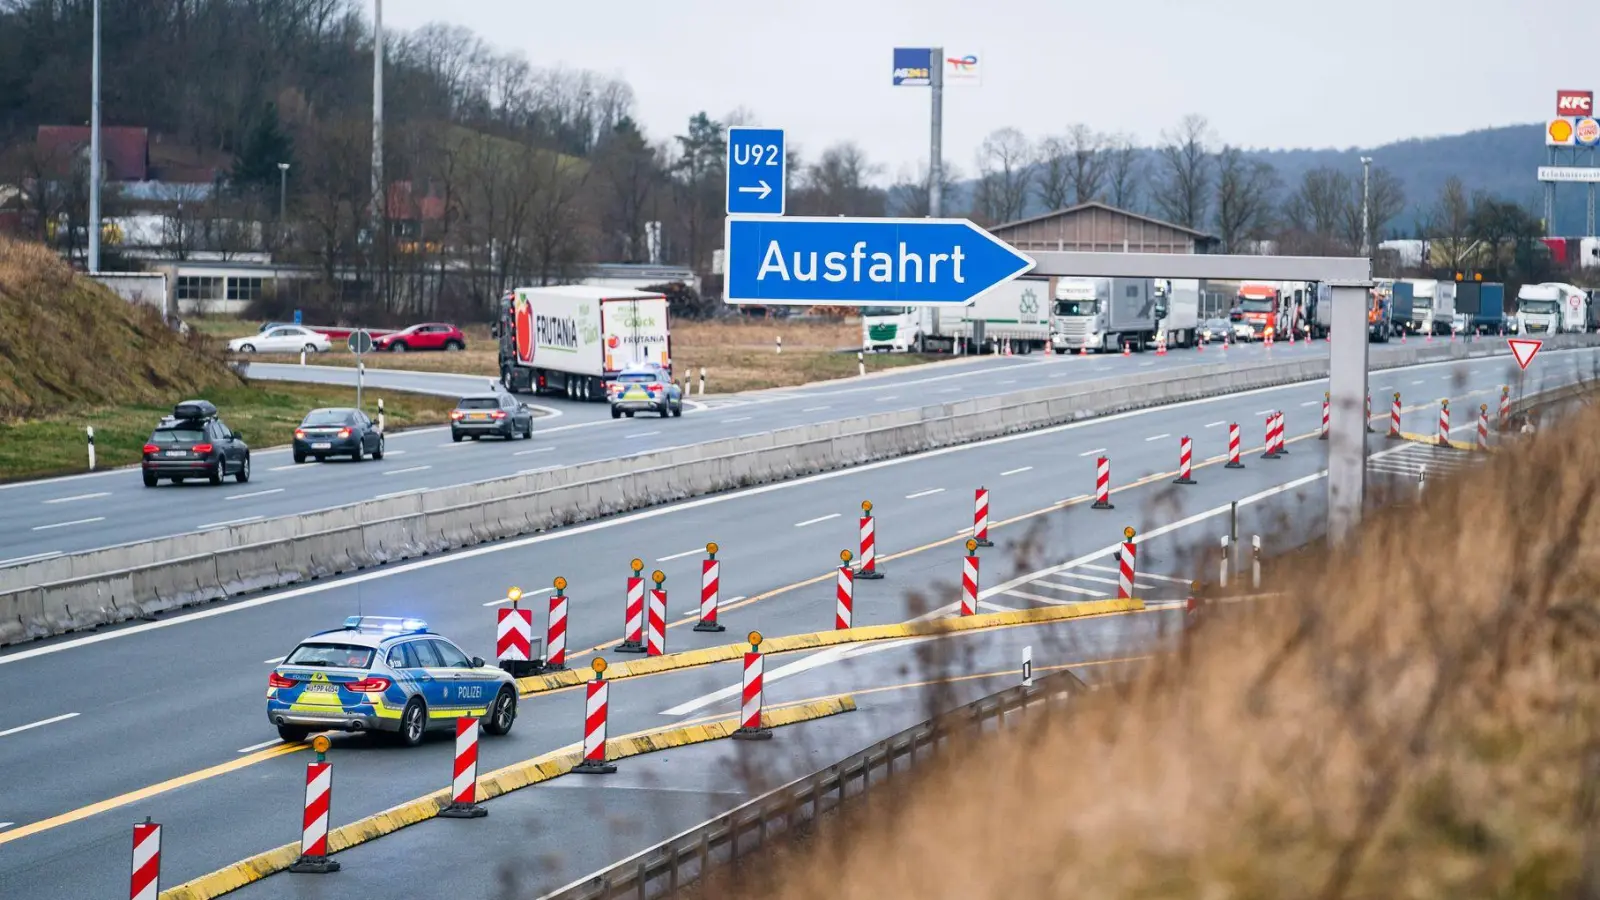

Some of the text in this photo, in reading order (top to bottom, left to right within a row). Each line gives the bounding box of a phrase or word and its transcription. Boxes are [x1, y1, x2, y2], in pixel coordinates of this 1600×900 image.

[1559, 96, 1590, 109] KFC
[734, 144, 778, 166] U92
[756, 240, 966, 284] Ausfahrt
[458, 686, 482, 698] POLIZEI
